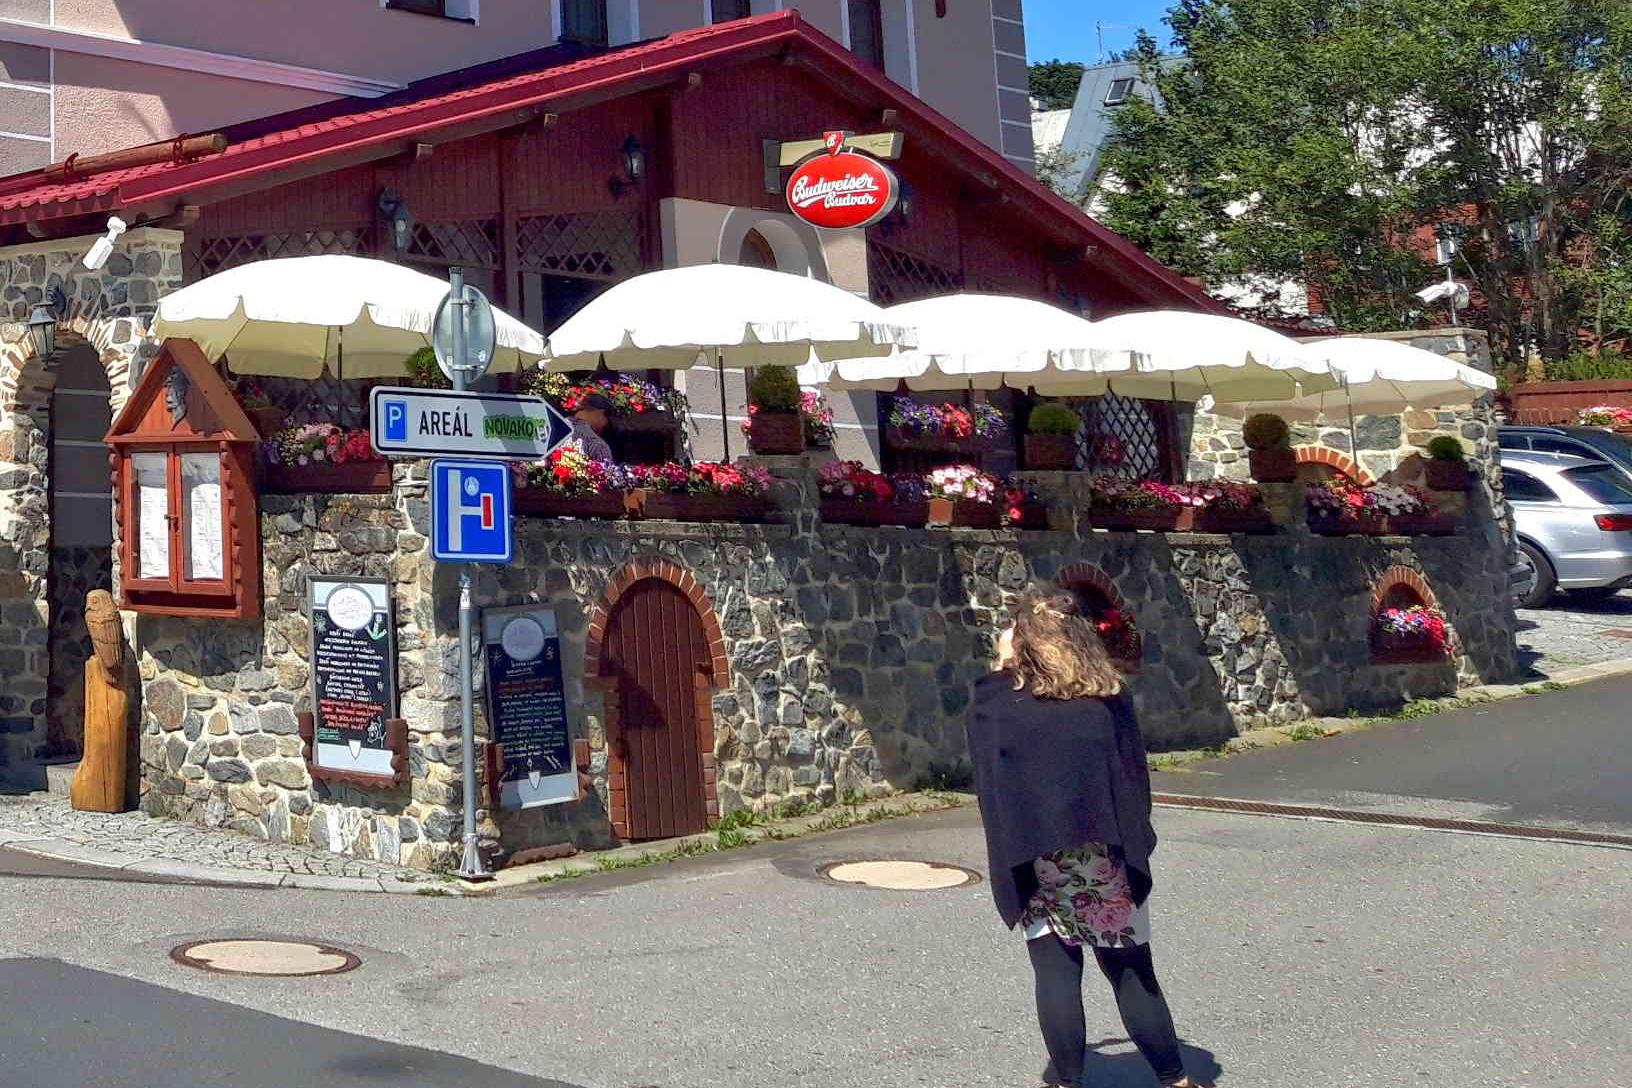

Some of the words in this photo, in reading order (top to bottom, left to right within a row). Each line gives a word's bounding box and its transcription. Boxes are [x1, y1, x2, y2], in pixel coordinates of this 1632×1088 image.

[792, 174, 879, 205] Budweiser
[824, 191, 877, 209] Budvar
[388, 406, 402, 430] P
[418, 405, 473, 438] AREÁL
